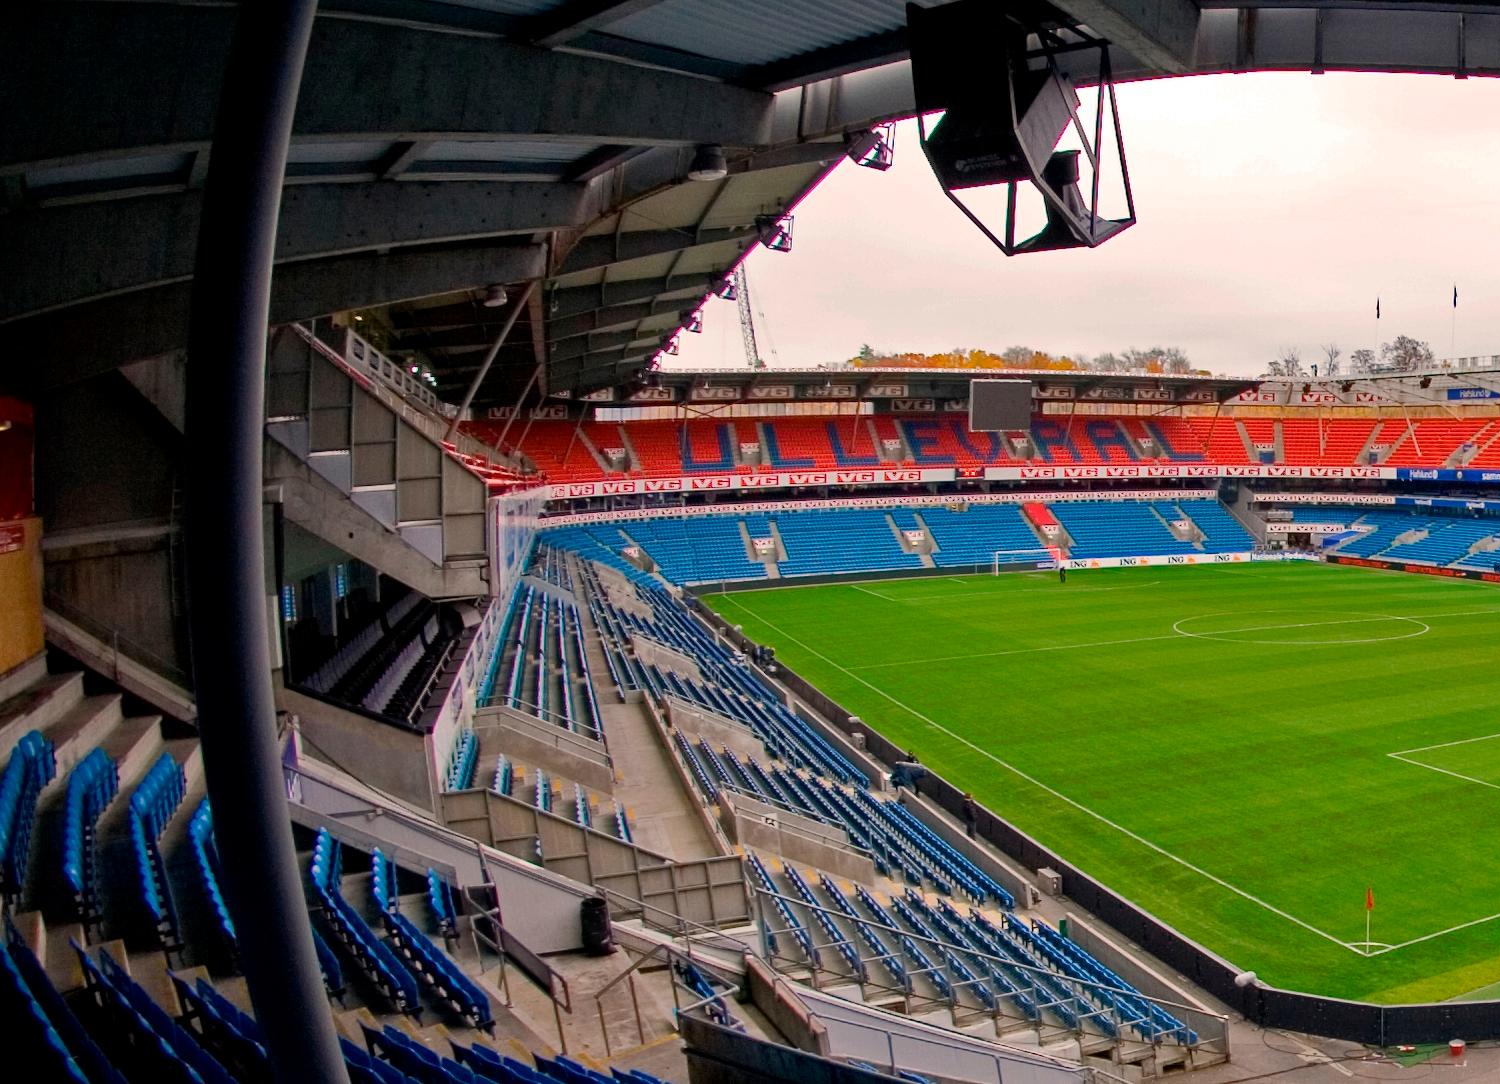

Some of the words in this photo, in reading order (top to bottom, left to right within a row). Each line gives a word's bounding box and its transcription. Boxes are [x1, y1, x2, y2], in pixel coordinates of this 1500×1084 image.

[639, 389, 671, 399] VG
[699, 387, 736, 398] VG
[752, 387, 788, 397] VG
[869, 386, 900, 396] VG
[1138, 391, 1170, 399] VG
[1460, 389, 1485, 398] Hafslund
[1240, 392, 1275, 401] VG
[1302, 394, 1335, 402] VG
[897, 401, 931, 410] VG
[1021, 468, 1055, 478] VG
[1064, 468, 1097, 477] VG
[1107, 468, 1138, 477] VG
[1148, 467, 1179, 477] VG
[1188, 467, 1219, 476] VG
[1227, 467, 1260, 476] VG
[1268, 467, 1302, 477] VG
[1310, 468, 1344, 477] VG
[1351, 468, 1380, 477] VG
[1409, 469, 1433, 479] Hafslund
[603, 482, 635, 494] VG
[646, 480, 682, 491] VG
[693, 478, 731, 489] VG
[742, 476, 779, 487] VG
[789, 474, 827, 485] VG
[838, 472, 874, 483] VG
[885, 471, 921, 481] VG
[1119, 558, 1137, 566] ING
[1168, 556, 1184, 564] ING
[1214, 554, 1230, 562] ING
[1070, 560, 1087, 568] ING
